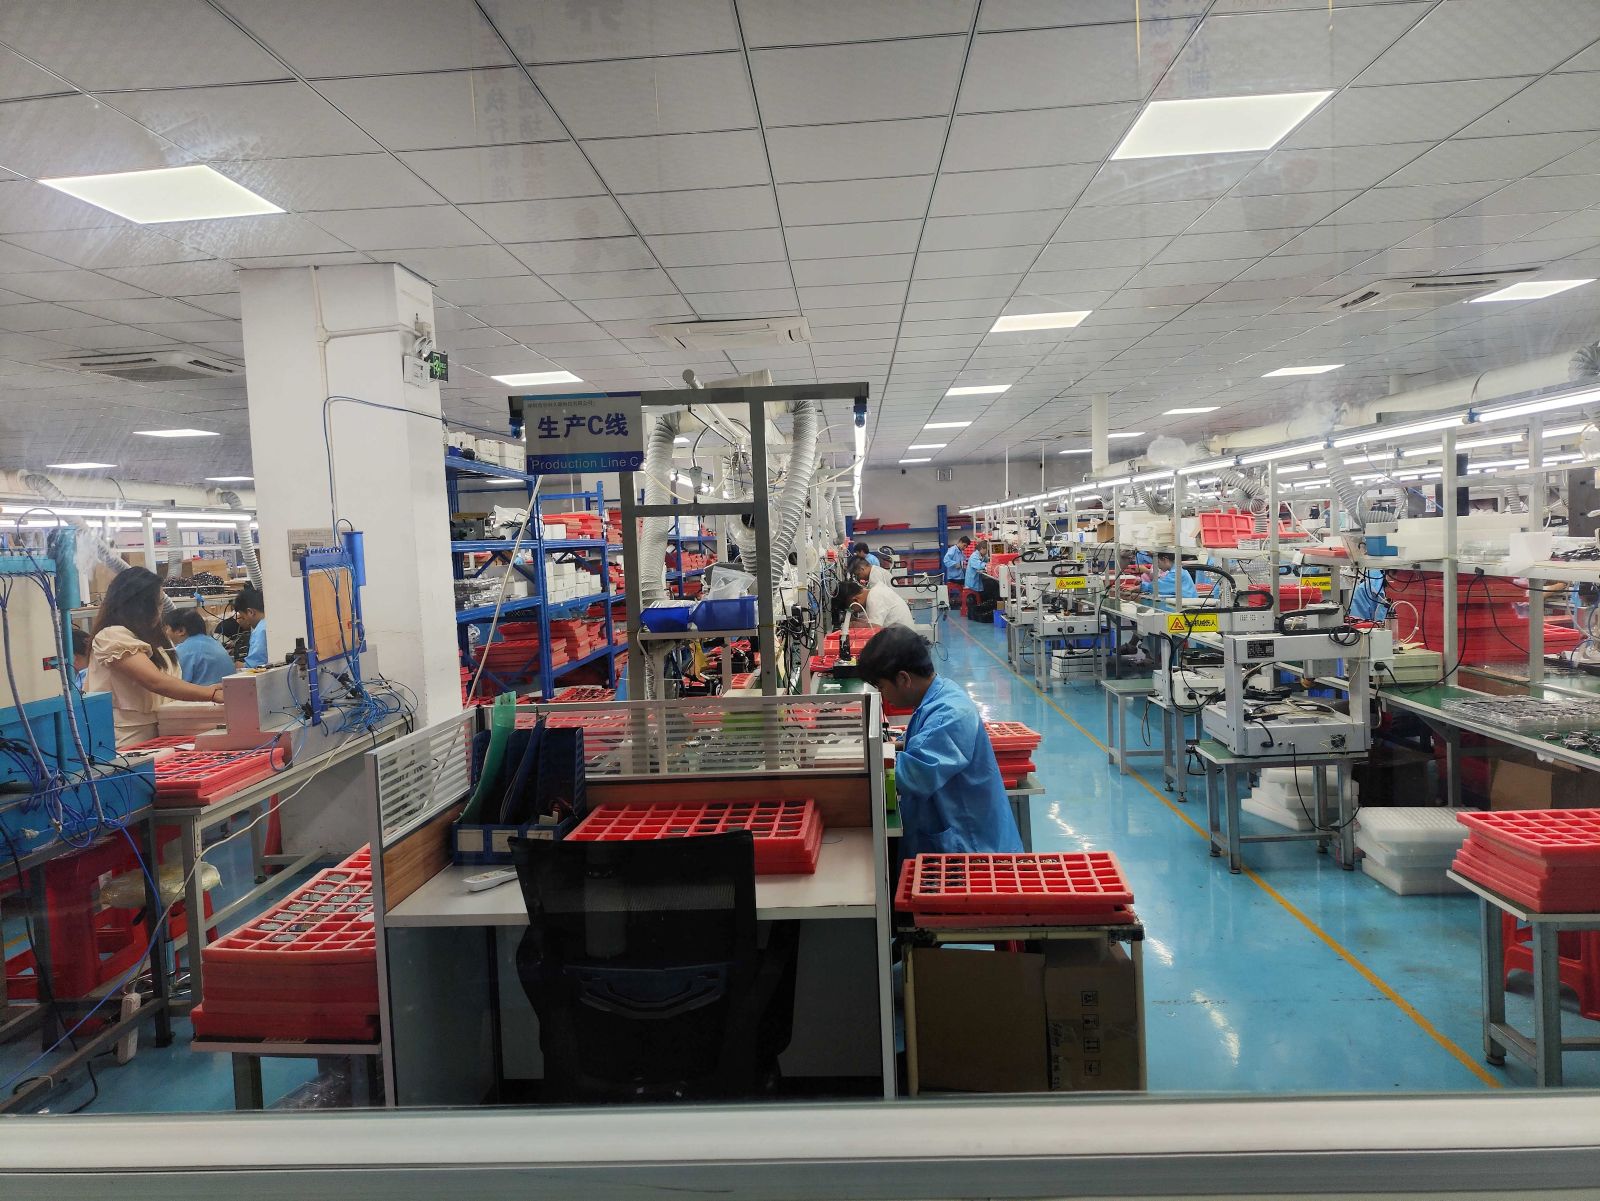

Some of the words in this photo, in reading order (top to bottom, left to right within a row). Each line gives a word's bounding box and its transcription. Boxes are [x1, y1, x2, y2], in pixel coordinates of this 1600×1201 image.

[537, 413, 629, 439] 生产C线
[531, 458, 598, 470] Production
[601, 457, 627, 468] Line
[630, 456, 639, 467] C
